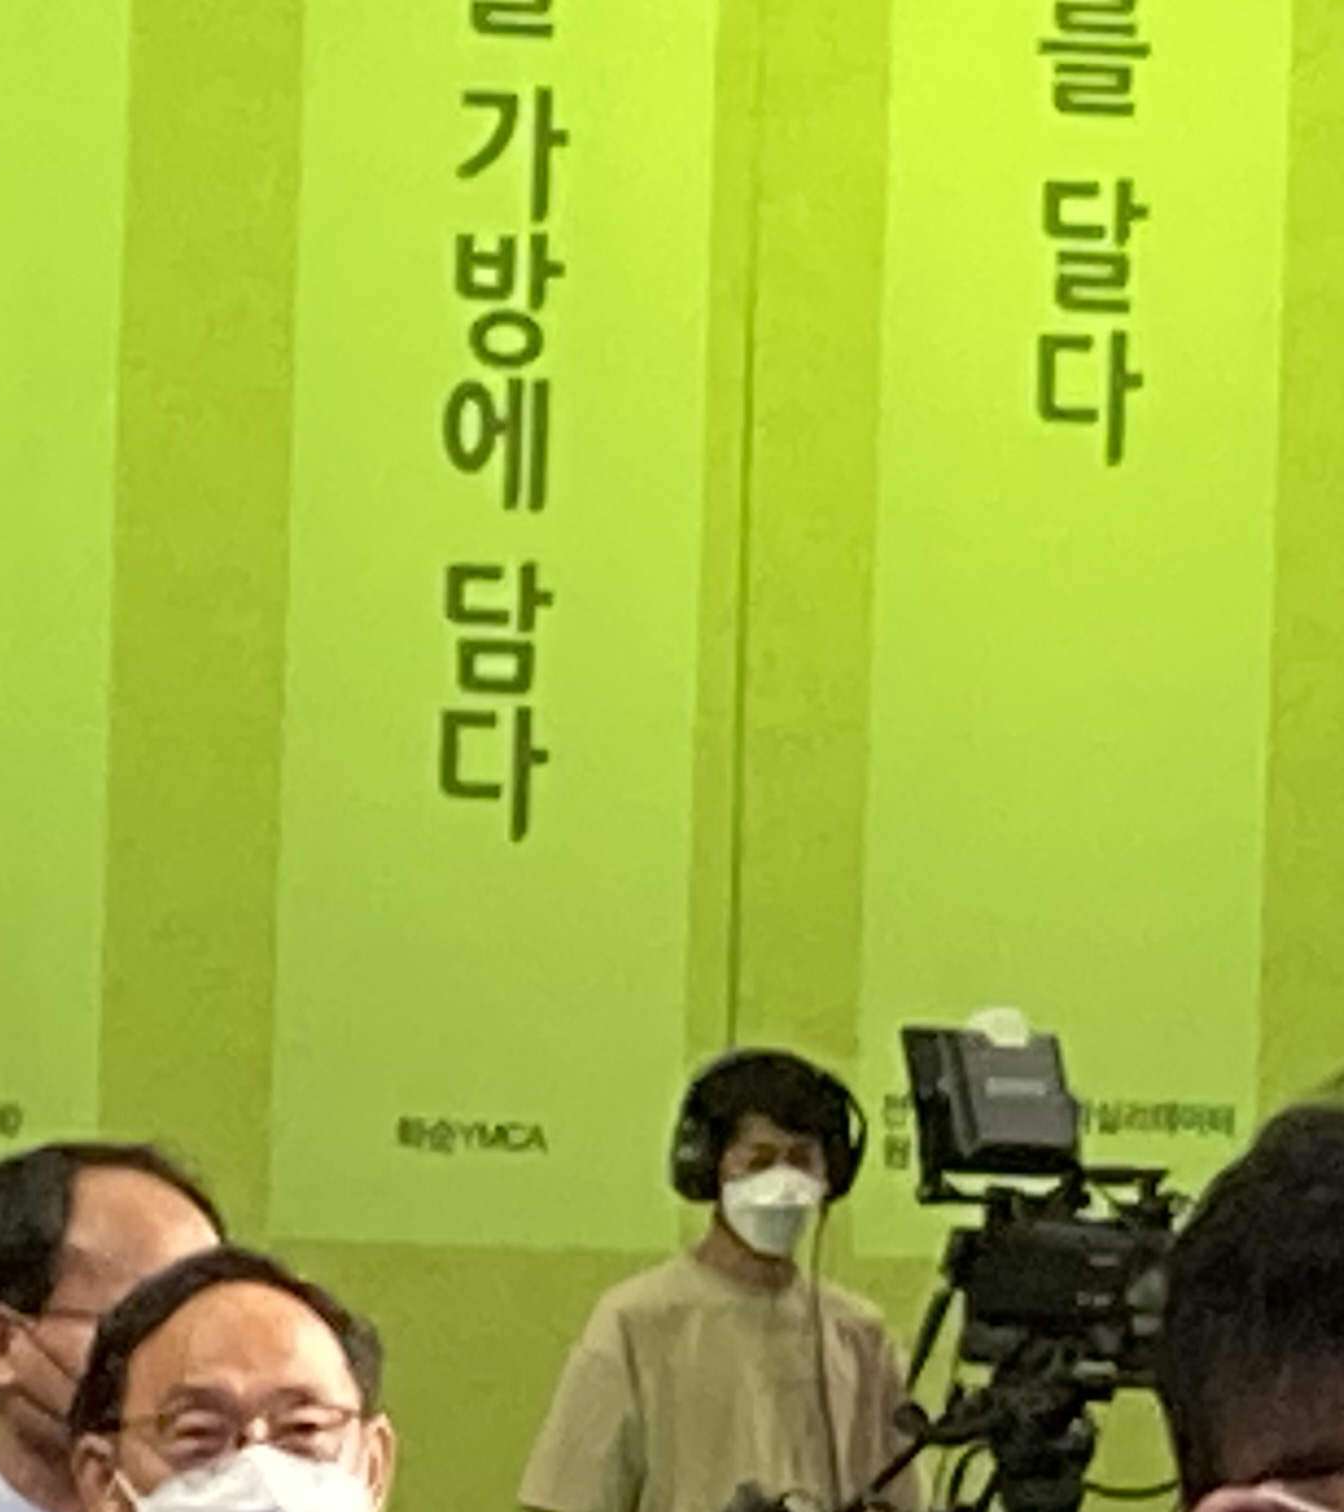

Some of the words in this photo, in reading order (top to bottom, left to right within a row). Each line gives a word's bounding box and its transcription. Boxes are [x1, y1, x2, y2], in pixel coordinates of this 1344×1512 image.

[443, 88, 570, 513] 가방에
[1038, 179, 1149, 467] 달다
[439, 561, 555, 844] 담다
